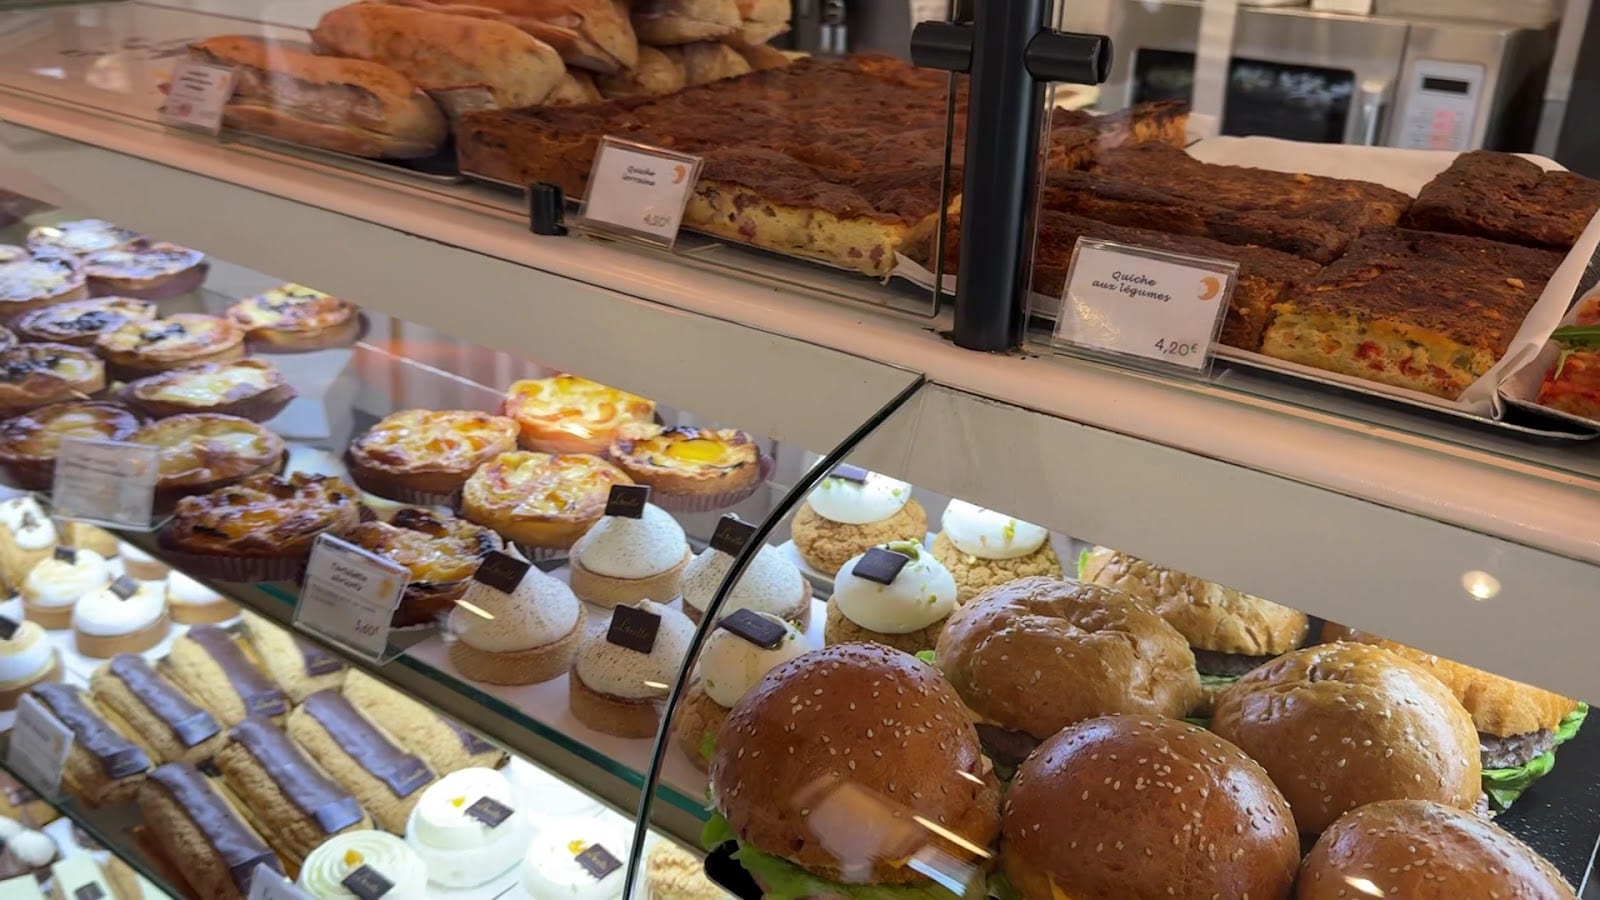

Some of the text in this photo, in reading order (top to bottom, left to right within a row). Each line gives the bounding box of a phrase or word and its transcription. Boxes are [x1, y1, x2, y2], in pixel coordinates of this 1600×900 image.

[1111, 270, 1158, 287] Quiche
[1092, 279, 1172, 302] aux légumes
[1154, 337, 1199, 356] 4,20€
